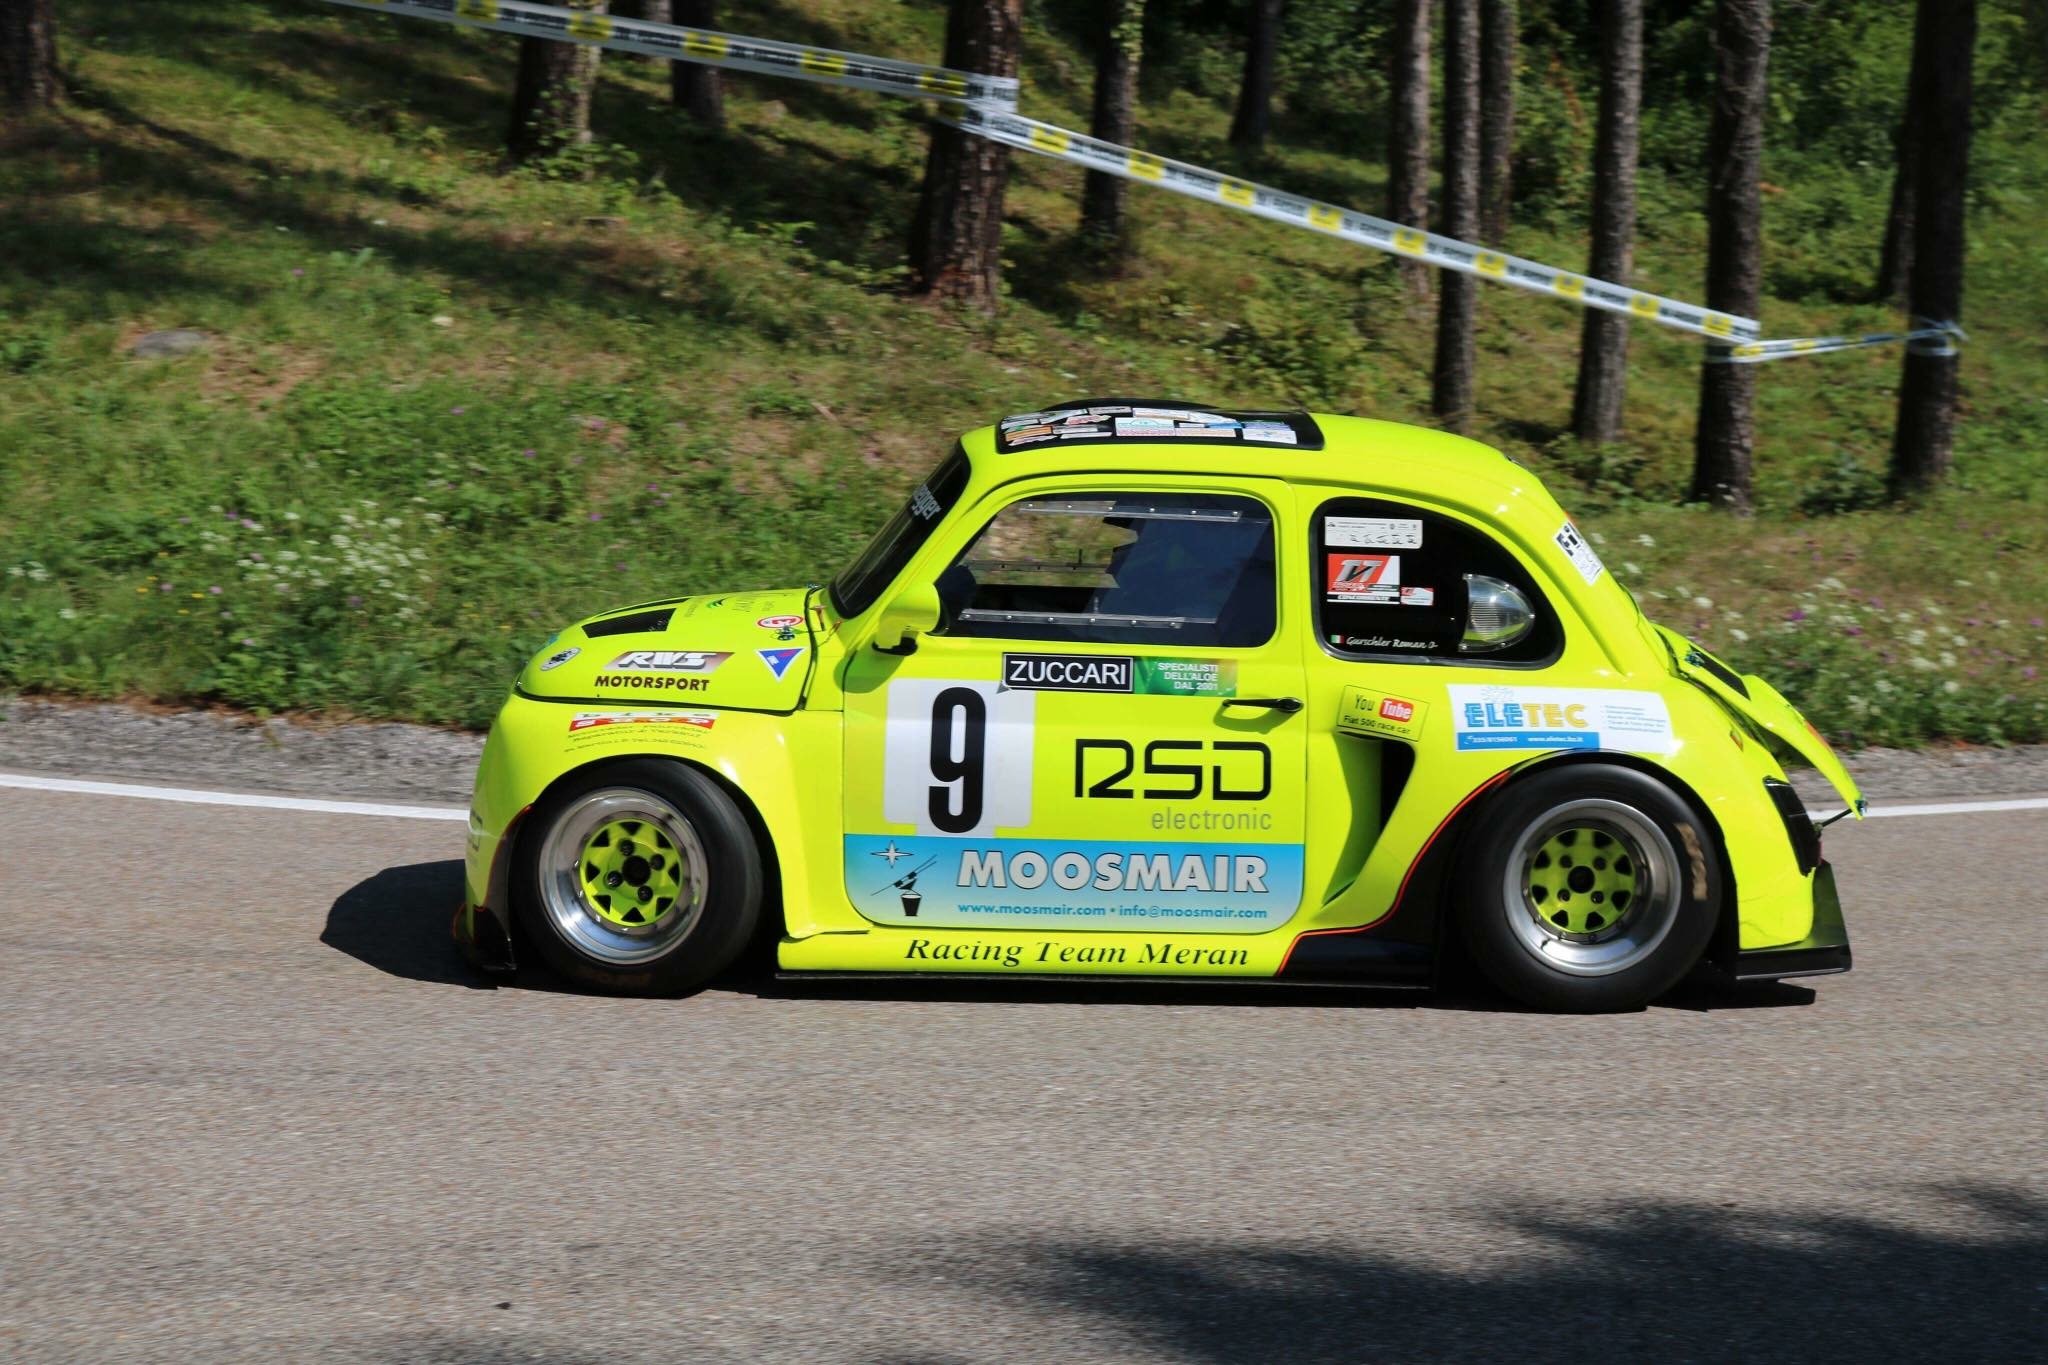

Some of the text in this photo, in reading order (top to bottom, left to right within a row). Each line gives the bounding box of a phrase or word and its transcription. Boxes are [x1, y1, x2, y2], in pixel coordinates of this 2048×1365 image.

[618, 651, 717, 669] RWS
[1157, 662, 1219, 673] SPECIALISTI
[594, 676, 710, 691] MOTORSPORT
[1009, 660, 1126, 685] ZUCCARI
[1163, 671, 1218, 682] DELL'ALOE
[1174, 681, 1219, 691] DAL 2001
[1355, 694, 1412, 720] You Tube
[1464, 703, 1589, 728] ELETEC
[1343, 715, 1411, 734] Fiat 500 race car
[928, 686, 986, 833] 9
[1151, 806, 1272, 831] electronic
[956, 849, 1269, 893] MOOSMAIR
[957, 902, 1268, 920] www.moosmair.com info@moosmair.com
[904, 938, 1248, 967] Racing Team Meran
